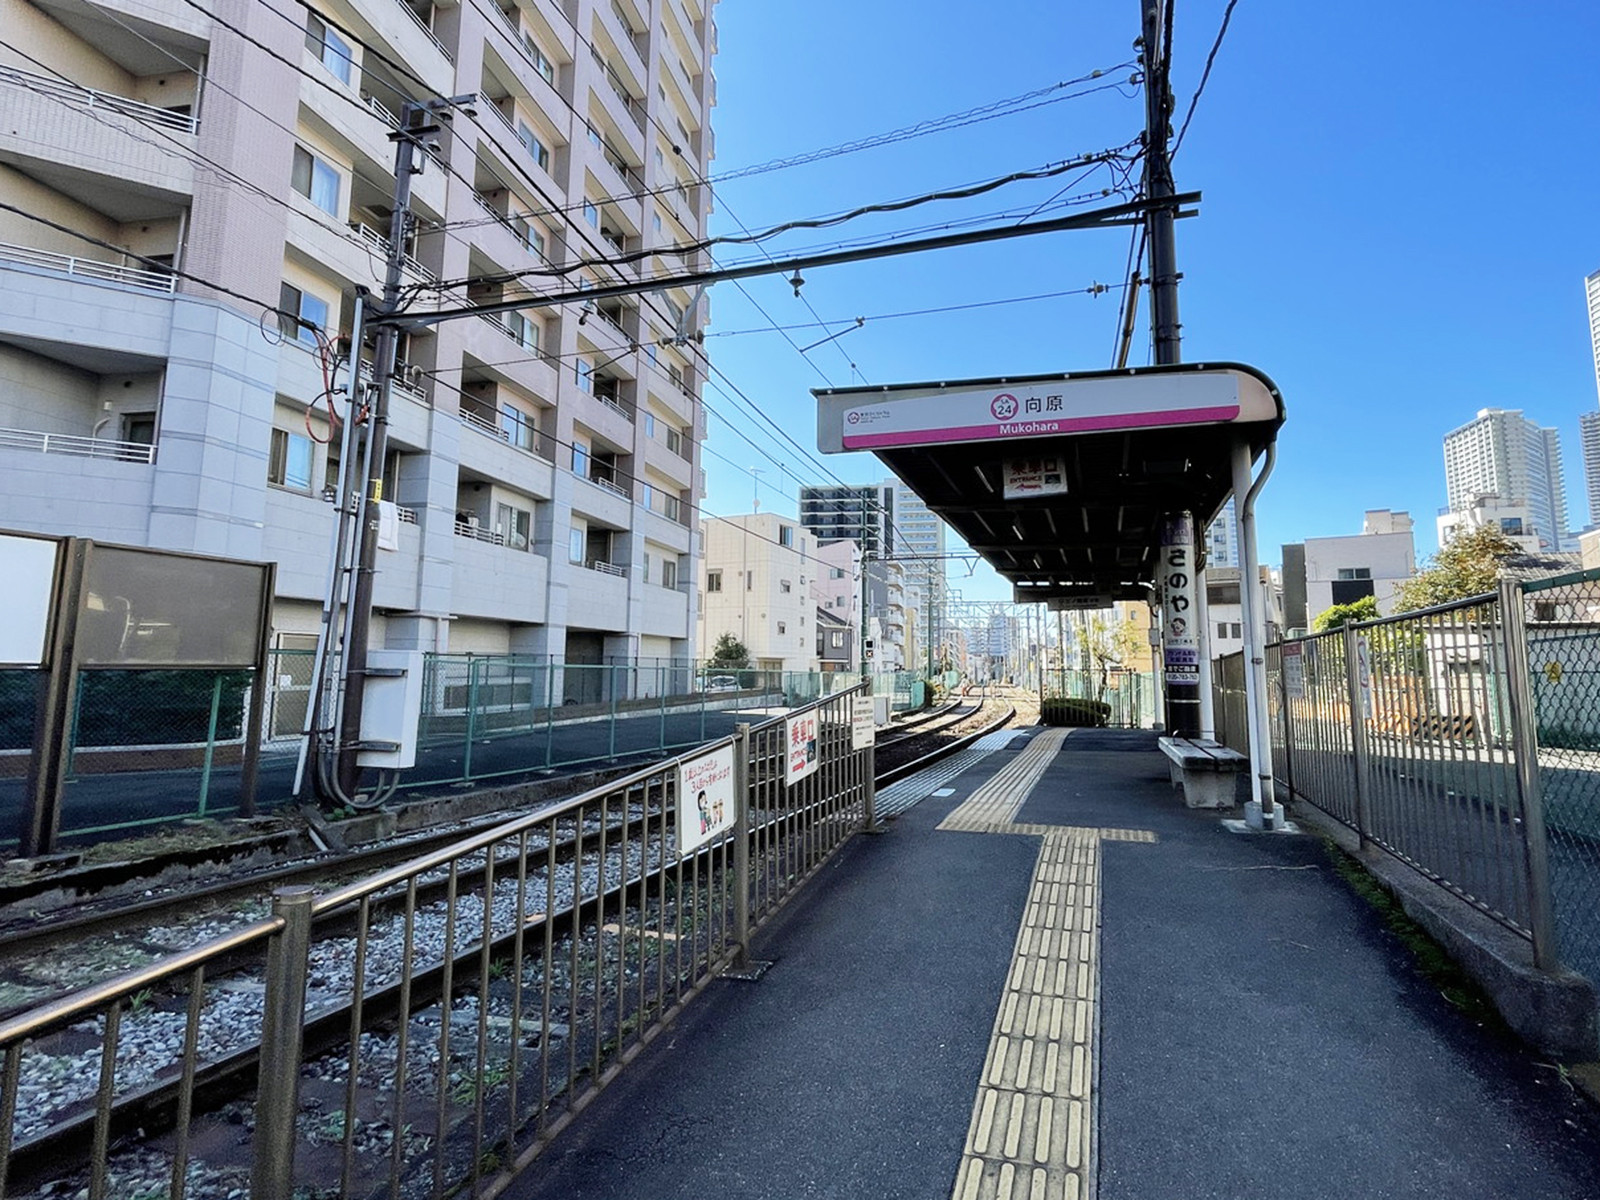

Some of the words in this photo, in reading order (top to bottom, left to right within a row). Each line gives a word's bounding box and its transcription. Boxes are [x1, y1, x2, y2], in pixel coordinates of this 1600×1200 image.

[998, 405, 1012, 415] 24
[1025, 395, 1063, 414] 向原
[1000, 422, 1059, 434] Mukohara
[1167, 549, 1189, 613] さのや
[792, 719, 814, 747] 乗車口
